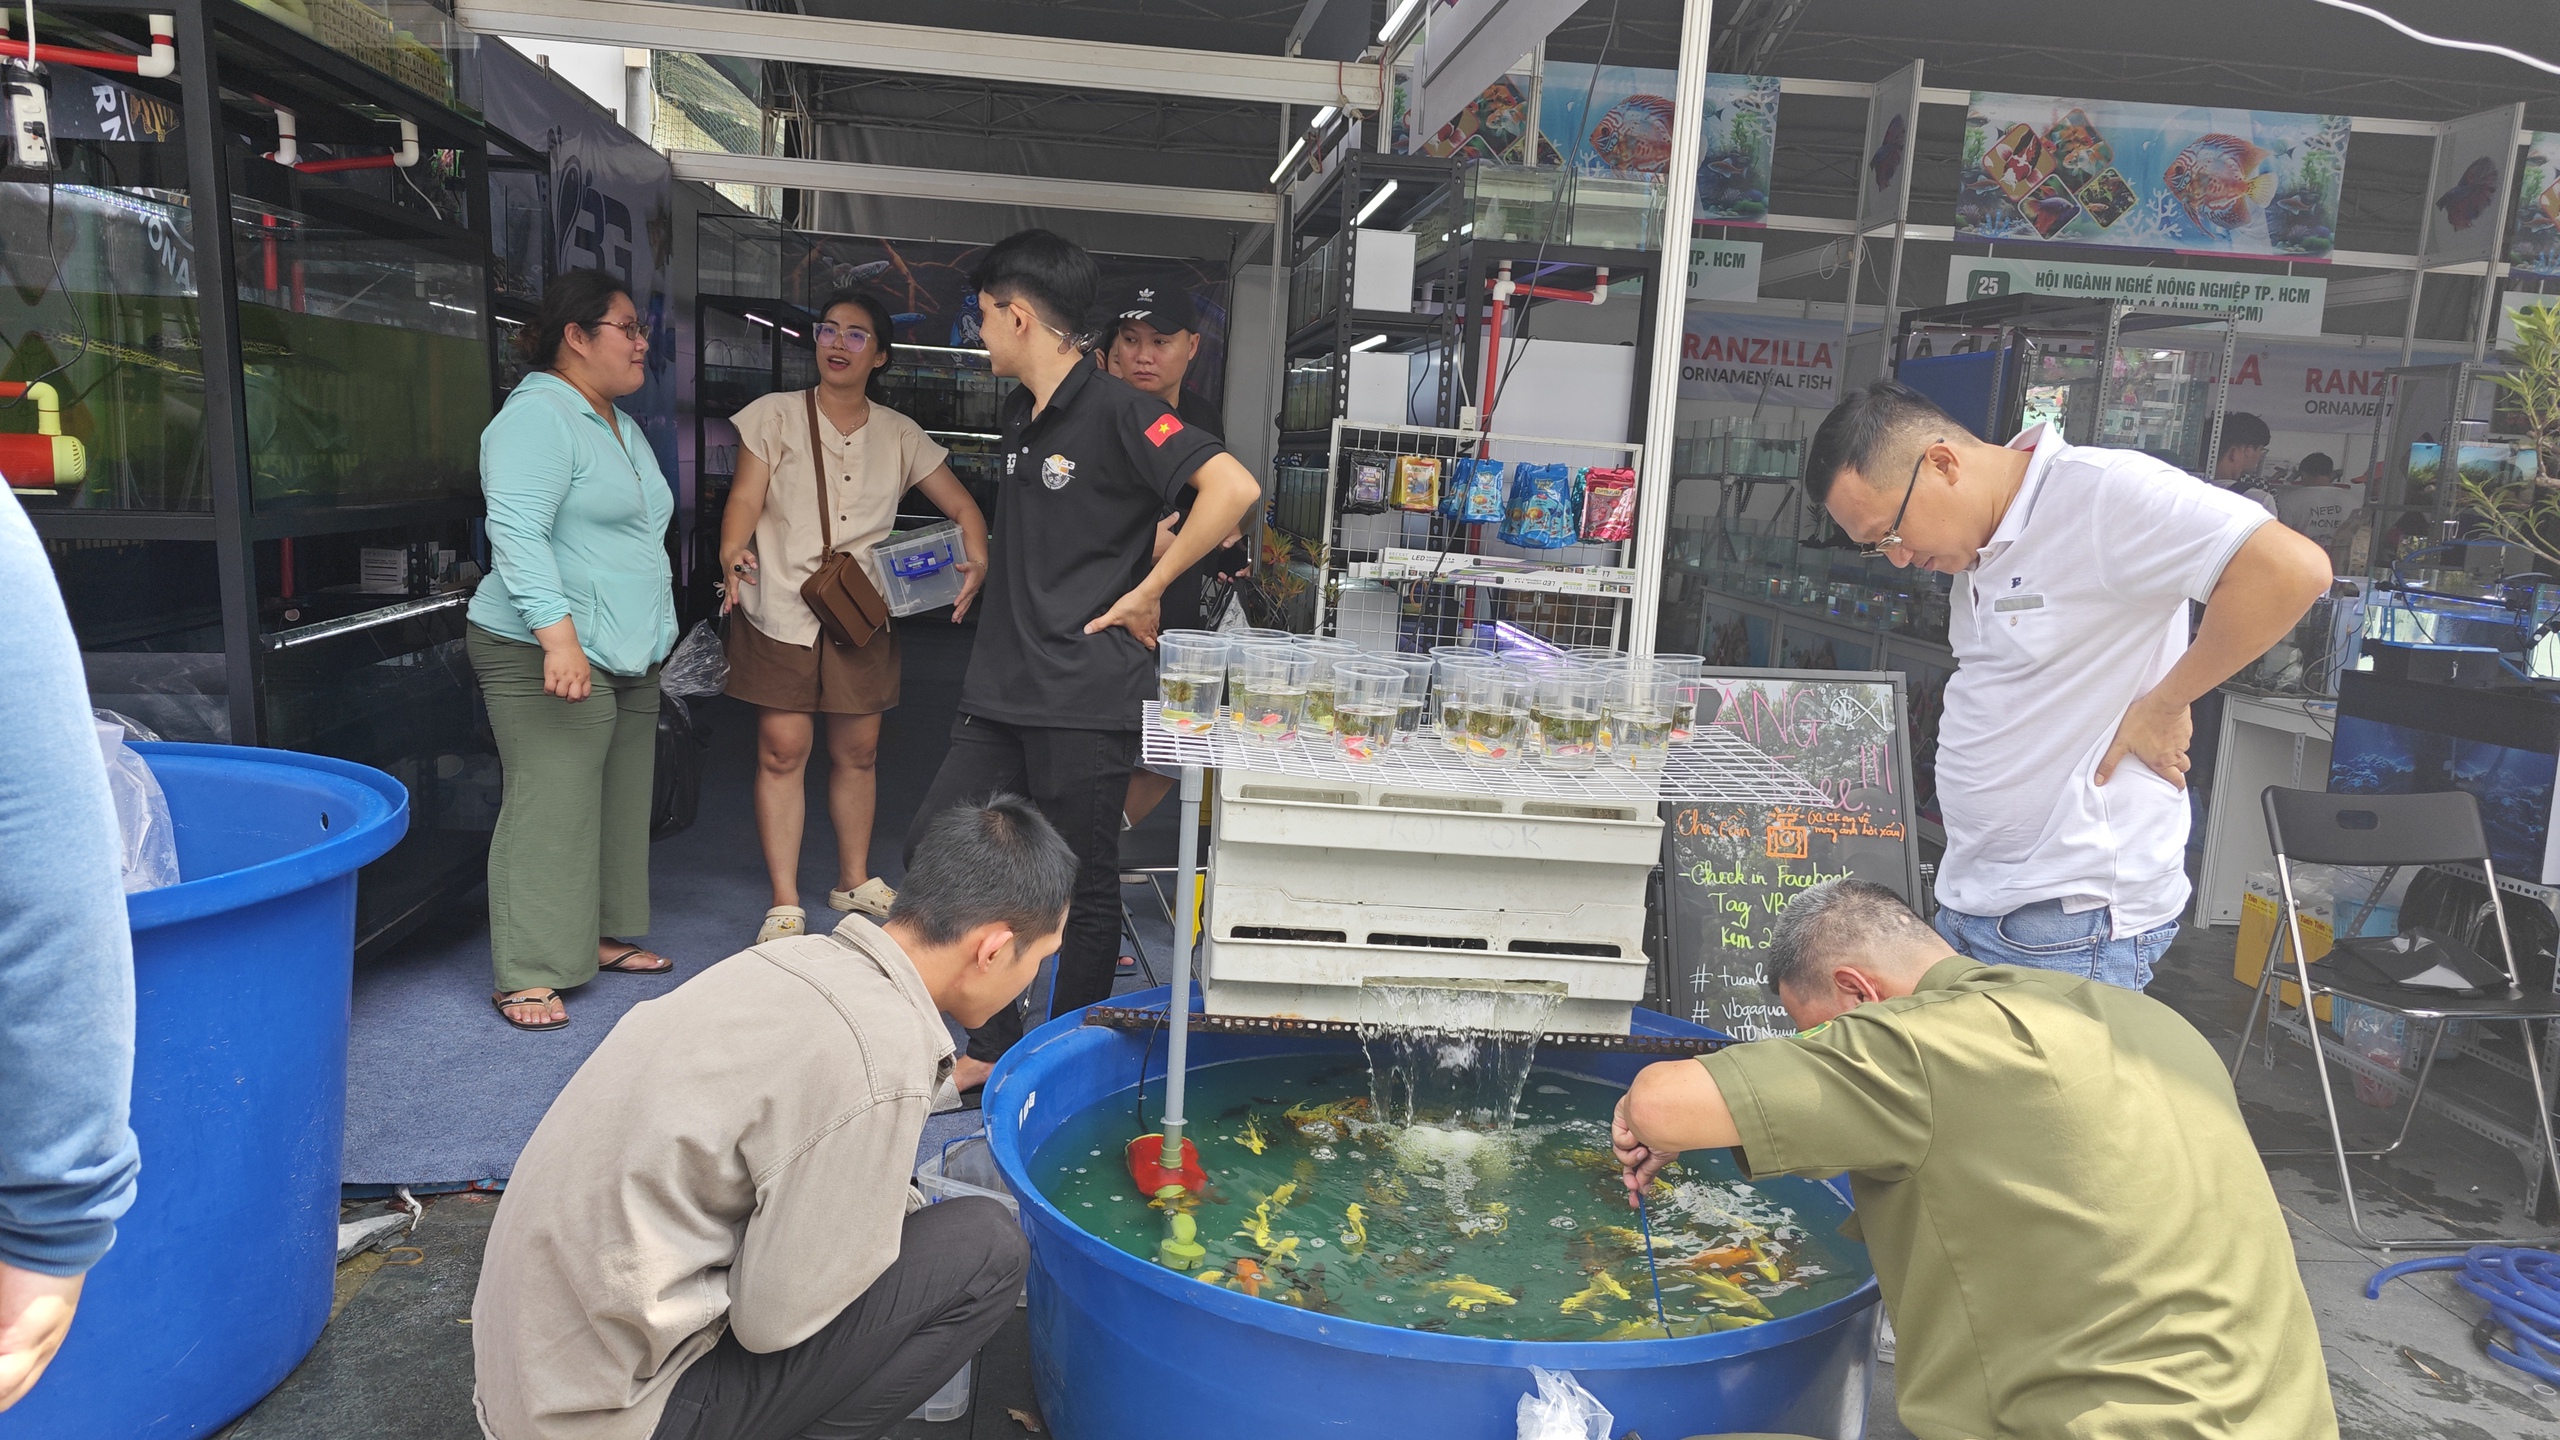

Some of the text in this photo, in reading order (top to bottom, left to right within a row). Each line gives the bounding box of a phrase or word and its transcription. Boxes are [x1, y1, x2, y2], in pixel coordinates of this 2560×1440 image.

[1713, 251, 1746, 269] HCM
[1977, 276, 1999, 295] 25
[2035, 269, 2310, 304] HỘI NGÀNH NGHỀ NÔNG NGHIỆP TP. HCM
[1682, 332, 1833, 369] RANZILLA
[1798, 374, 1833, 390] FISH
[2310, 505, 2342, 517] NEED
[1750, 872, 1768, 886] in
[1707, 892, 1752, 929] Tag
